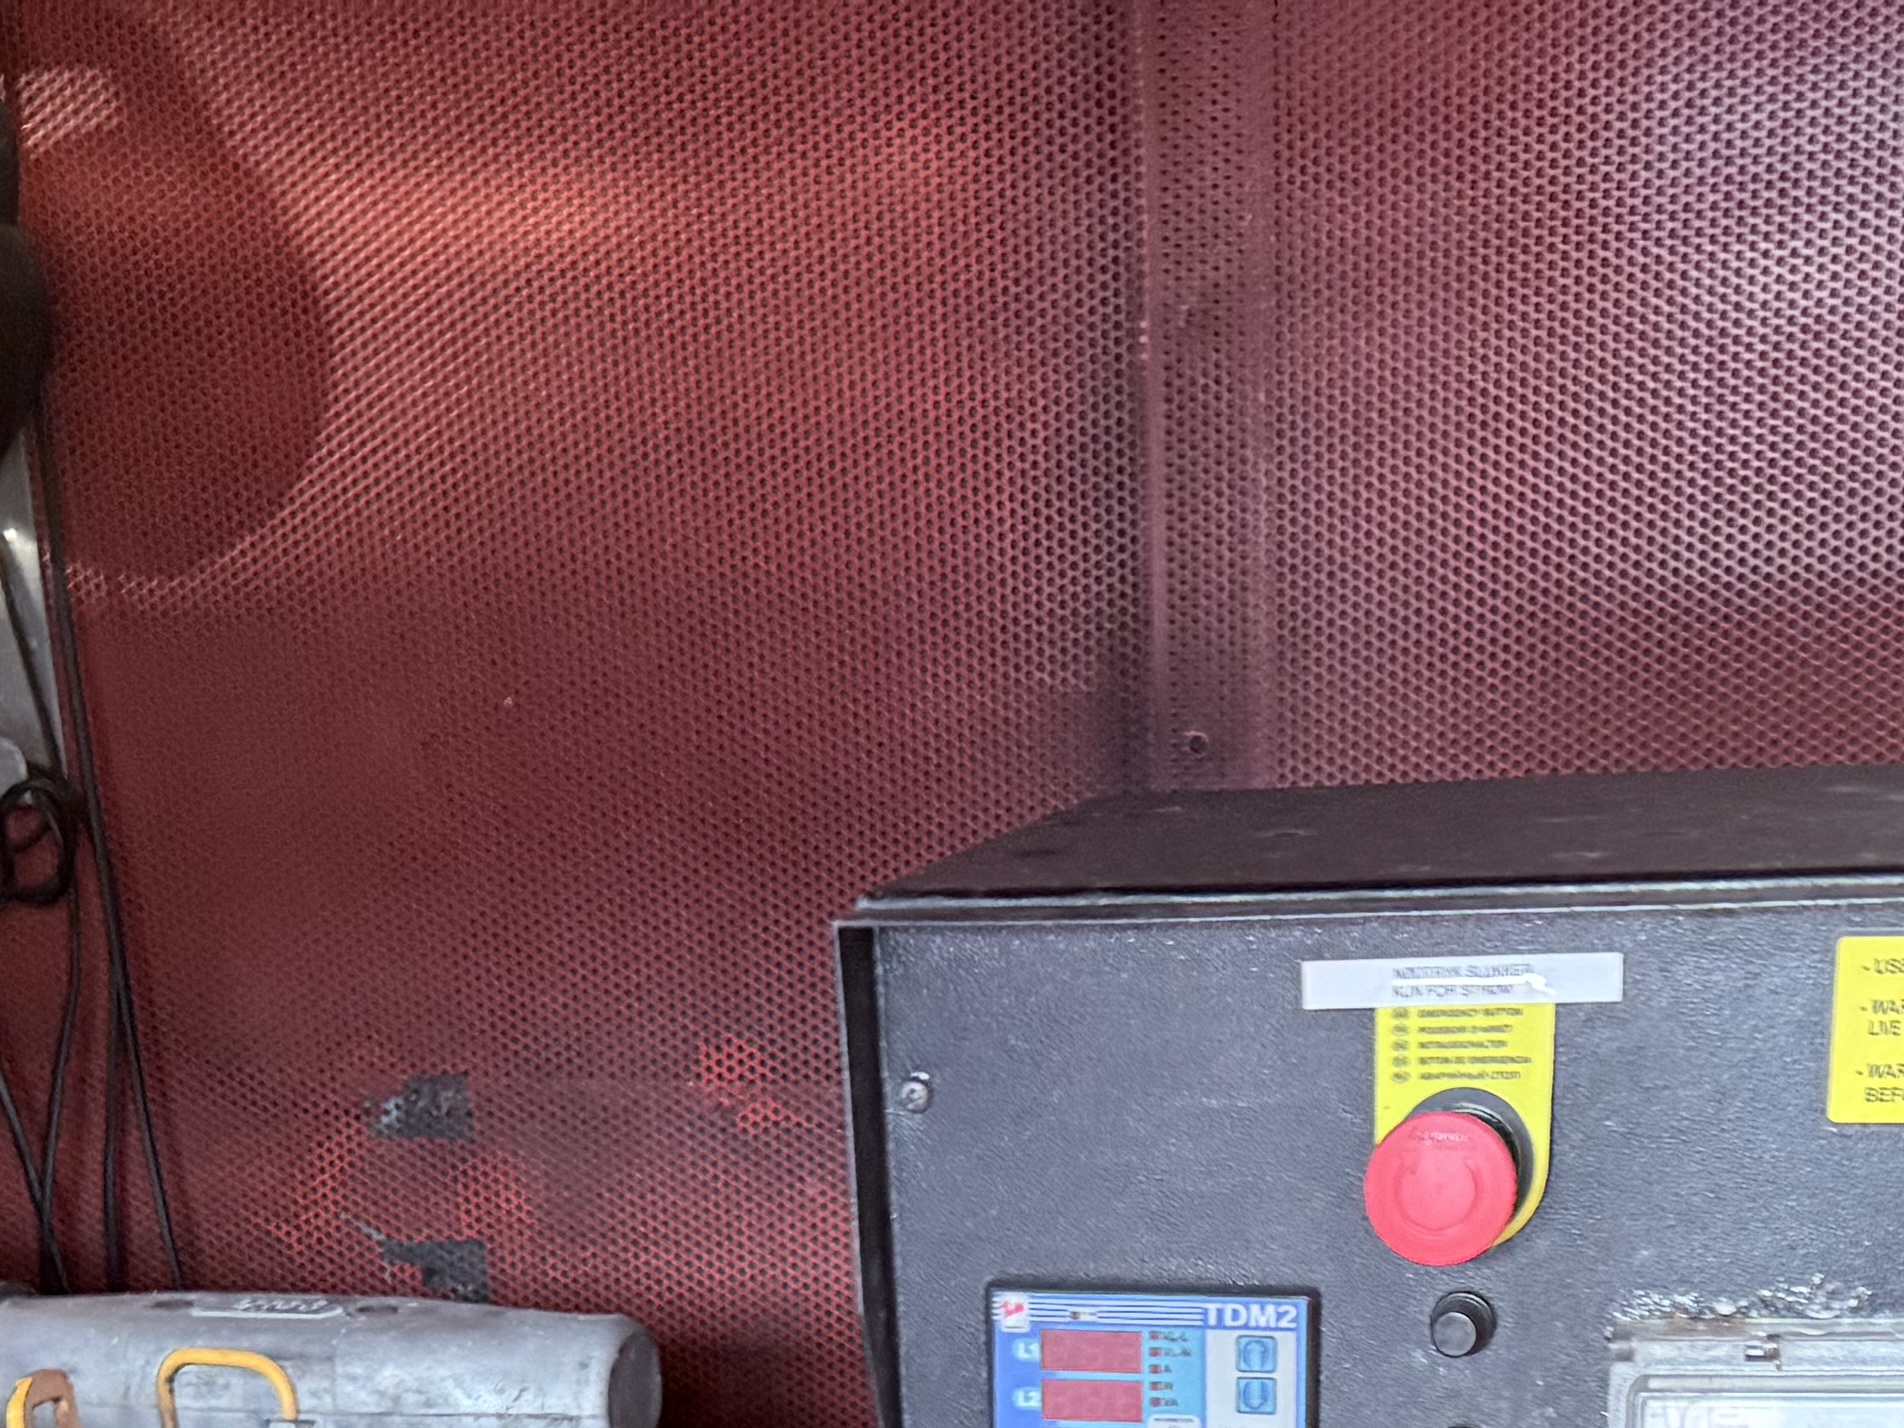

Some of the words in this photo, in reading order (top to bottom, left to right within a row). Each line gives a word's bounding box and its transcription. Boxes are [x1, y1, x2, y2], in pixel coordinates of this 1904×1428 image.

[1868, 1021, 1901, 1036] LIVE
[1205, 1303, 1296, 1327] TDM2
[1018, 1390, 1041, 1407] L2
